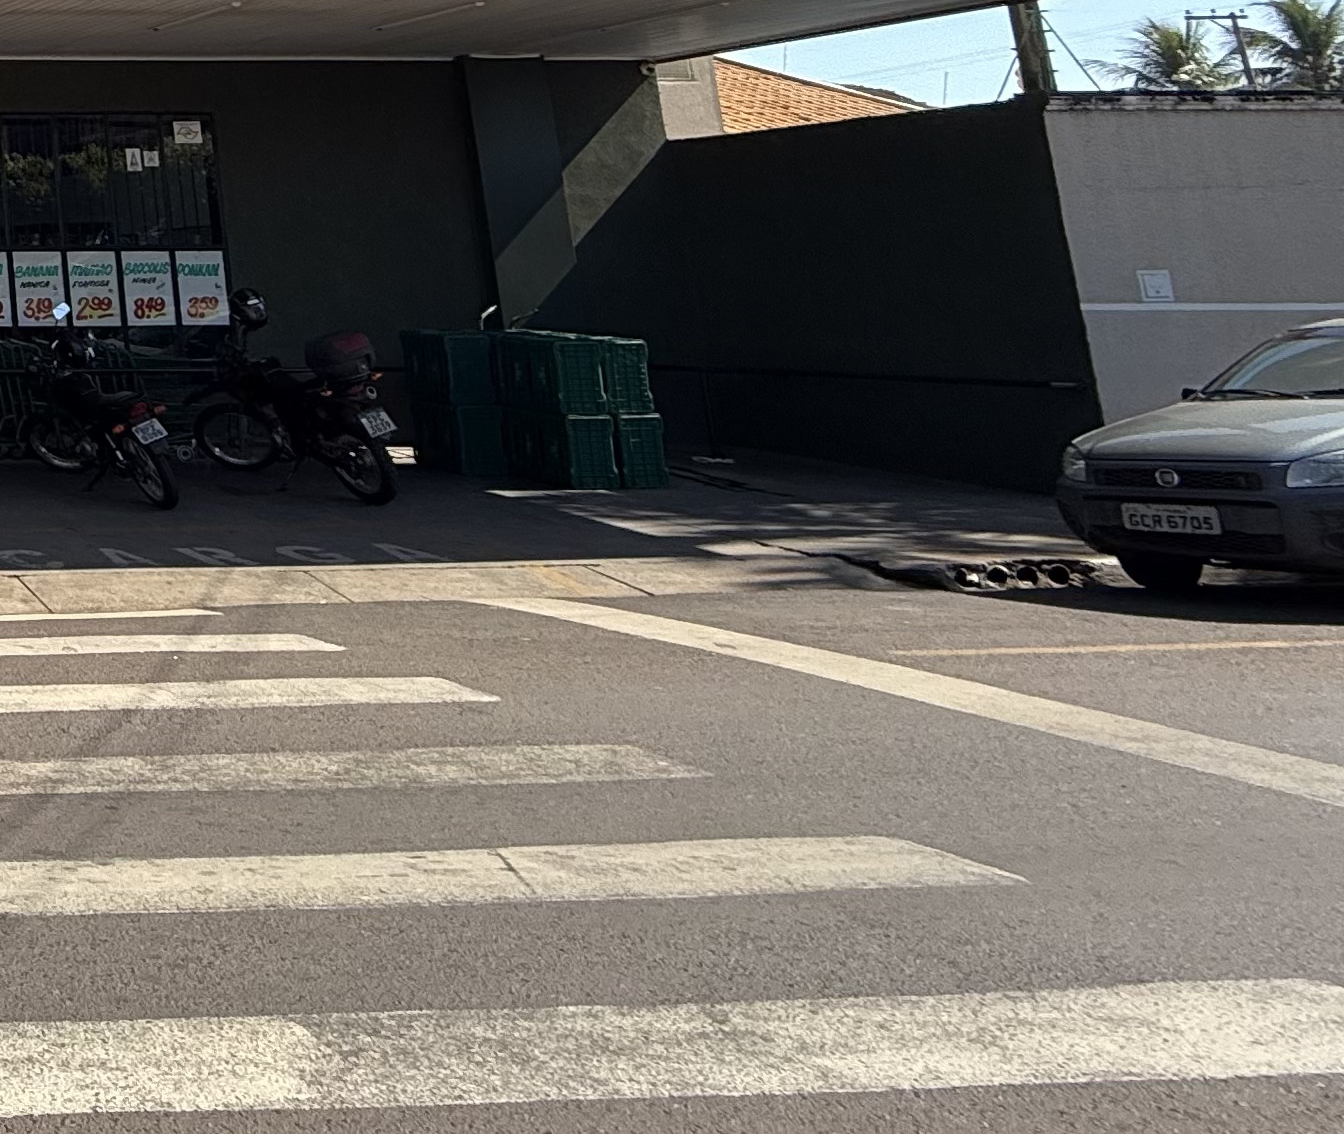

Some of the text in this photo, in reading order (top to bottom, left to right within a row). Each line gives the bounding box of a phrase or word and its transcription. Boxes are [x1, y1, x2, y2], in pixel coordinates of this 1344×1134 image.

[15, 265, 59, 278] BANANA
[1129, 513, 1214, 530] GCR 6705
